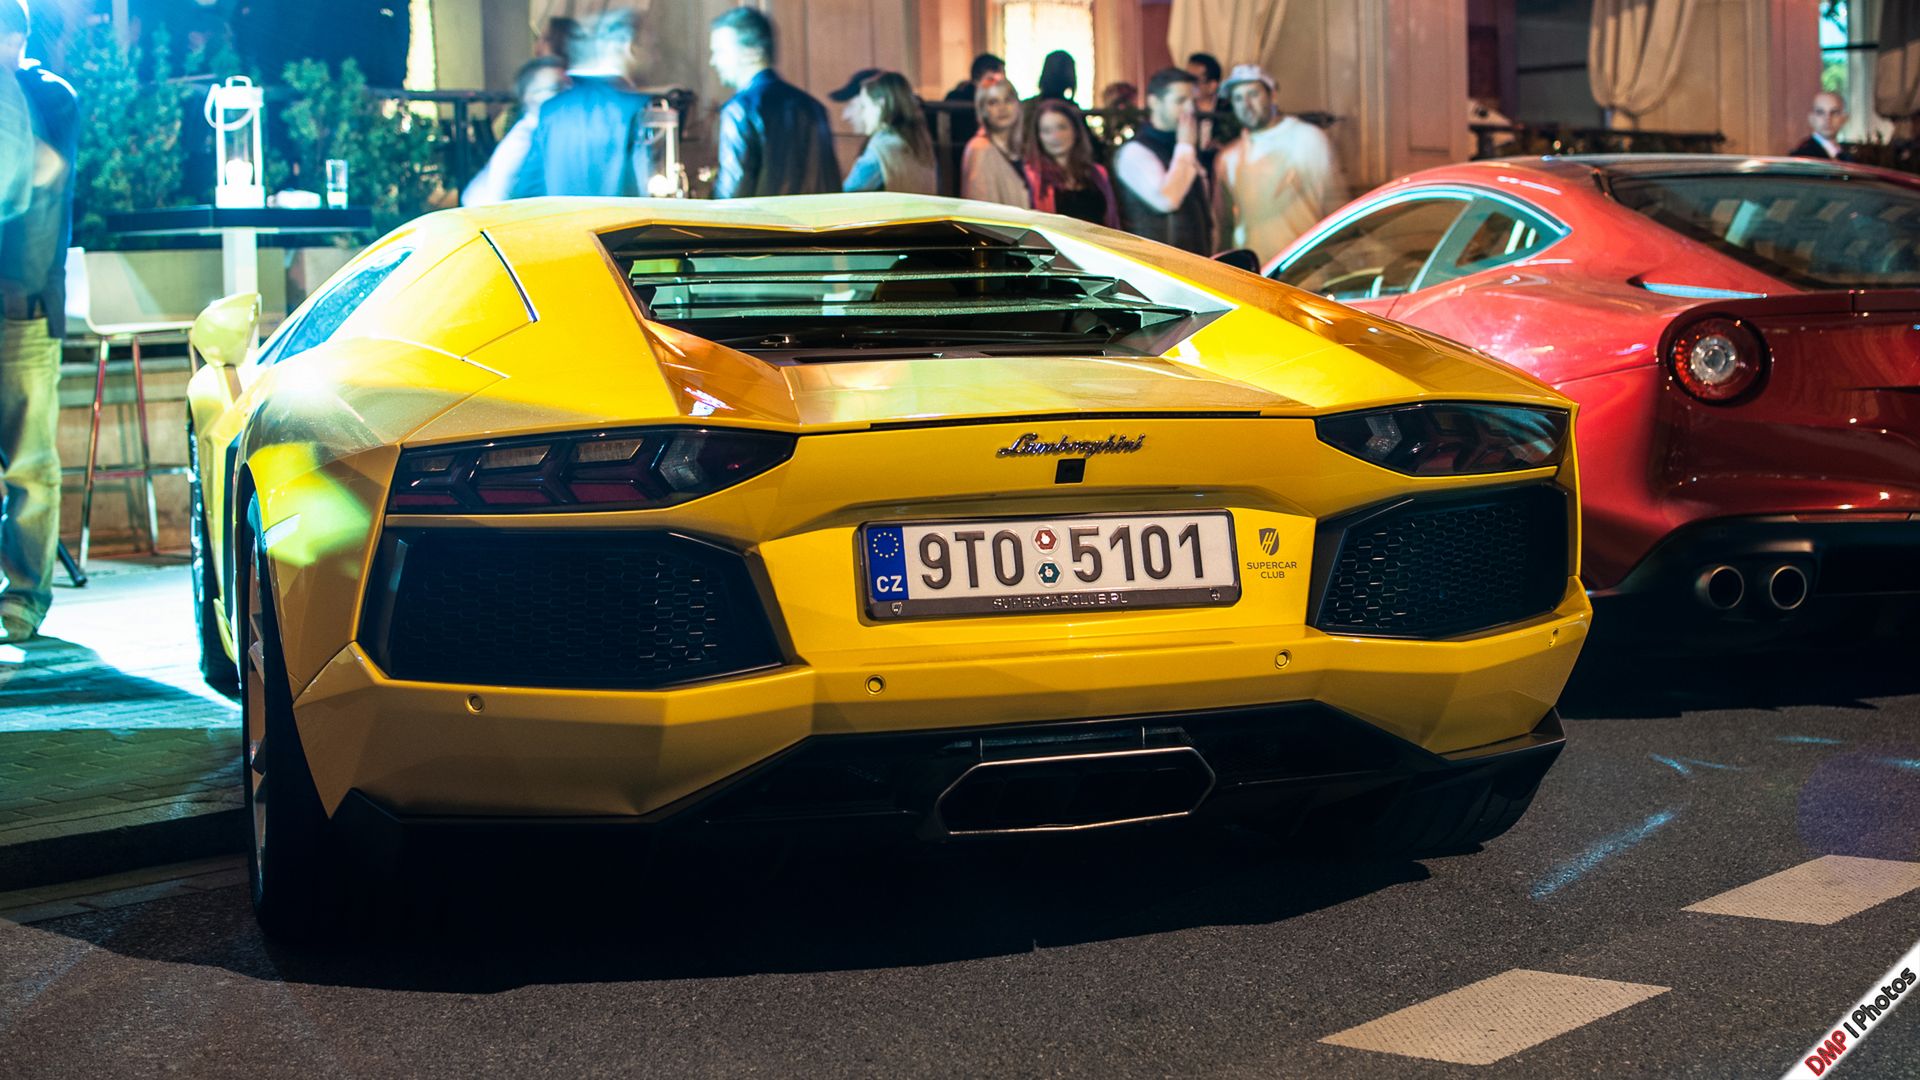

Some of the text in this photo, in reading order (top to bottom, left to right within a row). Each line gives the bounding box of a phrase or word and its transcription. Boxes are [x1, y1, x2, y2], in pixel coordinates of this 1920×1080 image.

[996, 432, 1146, 459] Lamborghini
[919, 522, 1204, 590] 9T0 5101
[1246, 561, 1298, 570] SUPERCAR
[1260, 570, 1285, 579] CLUB
[876, 575, 903, 593] CZ
